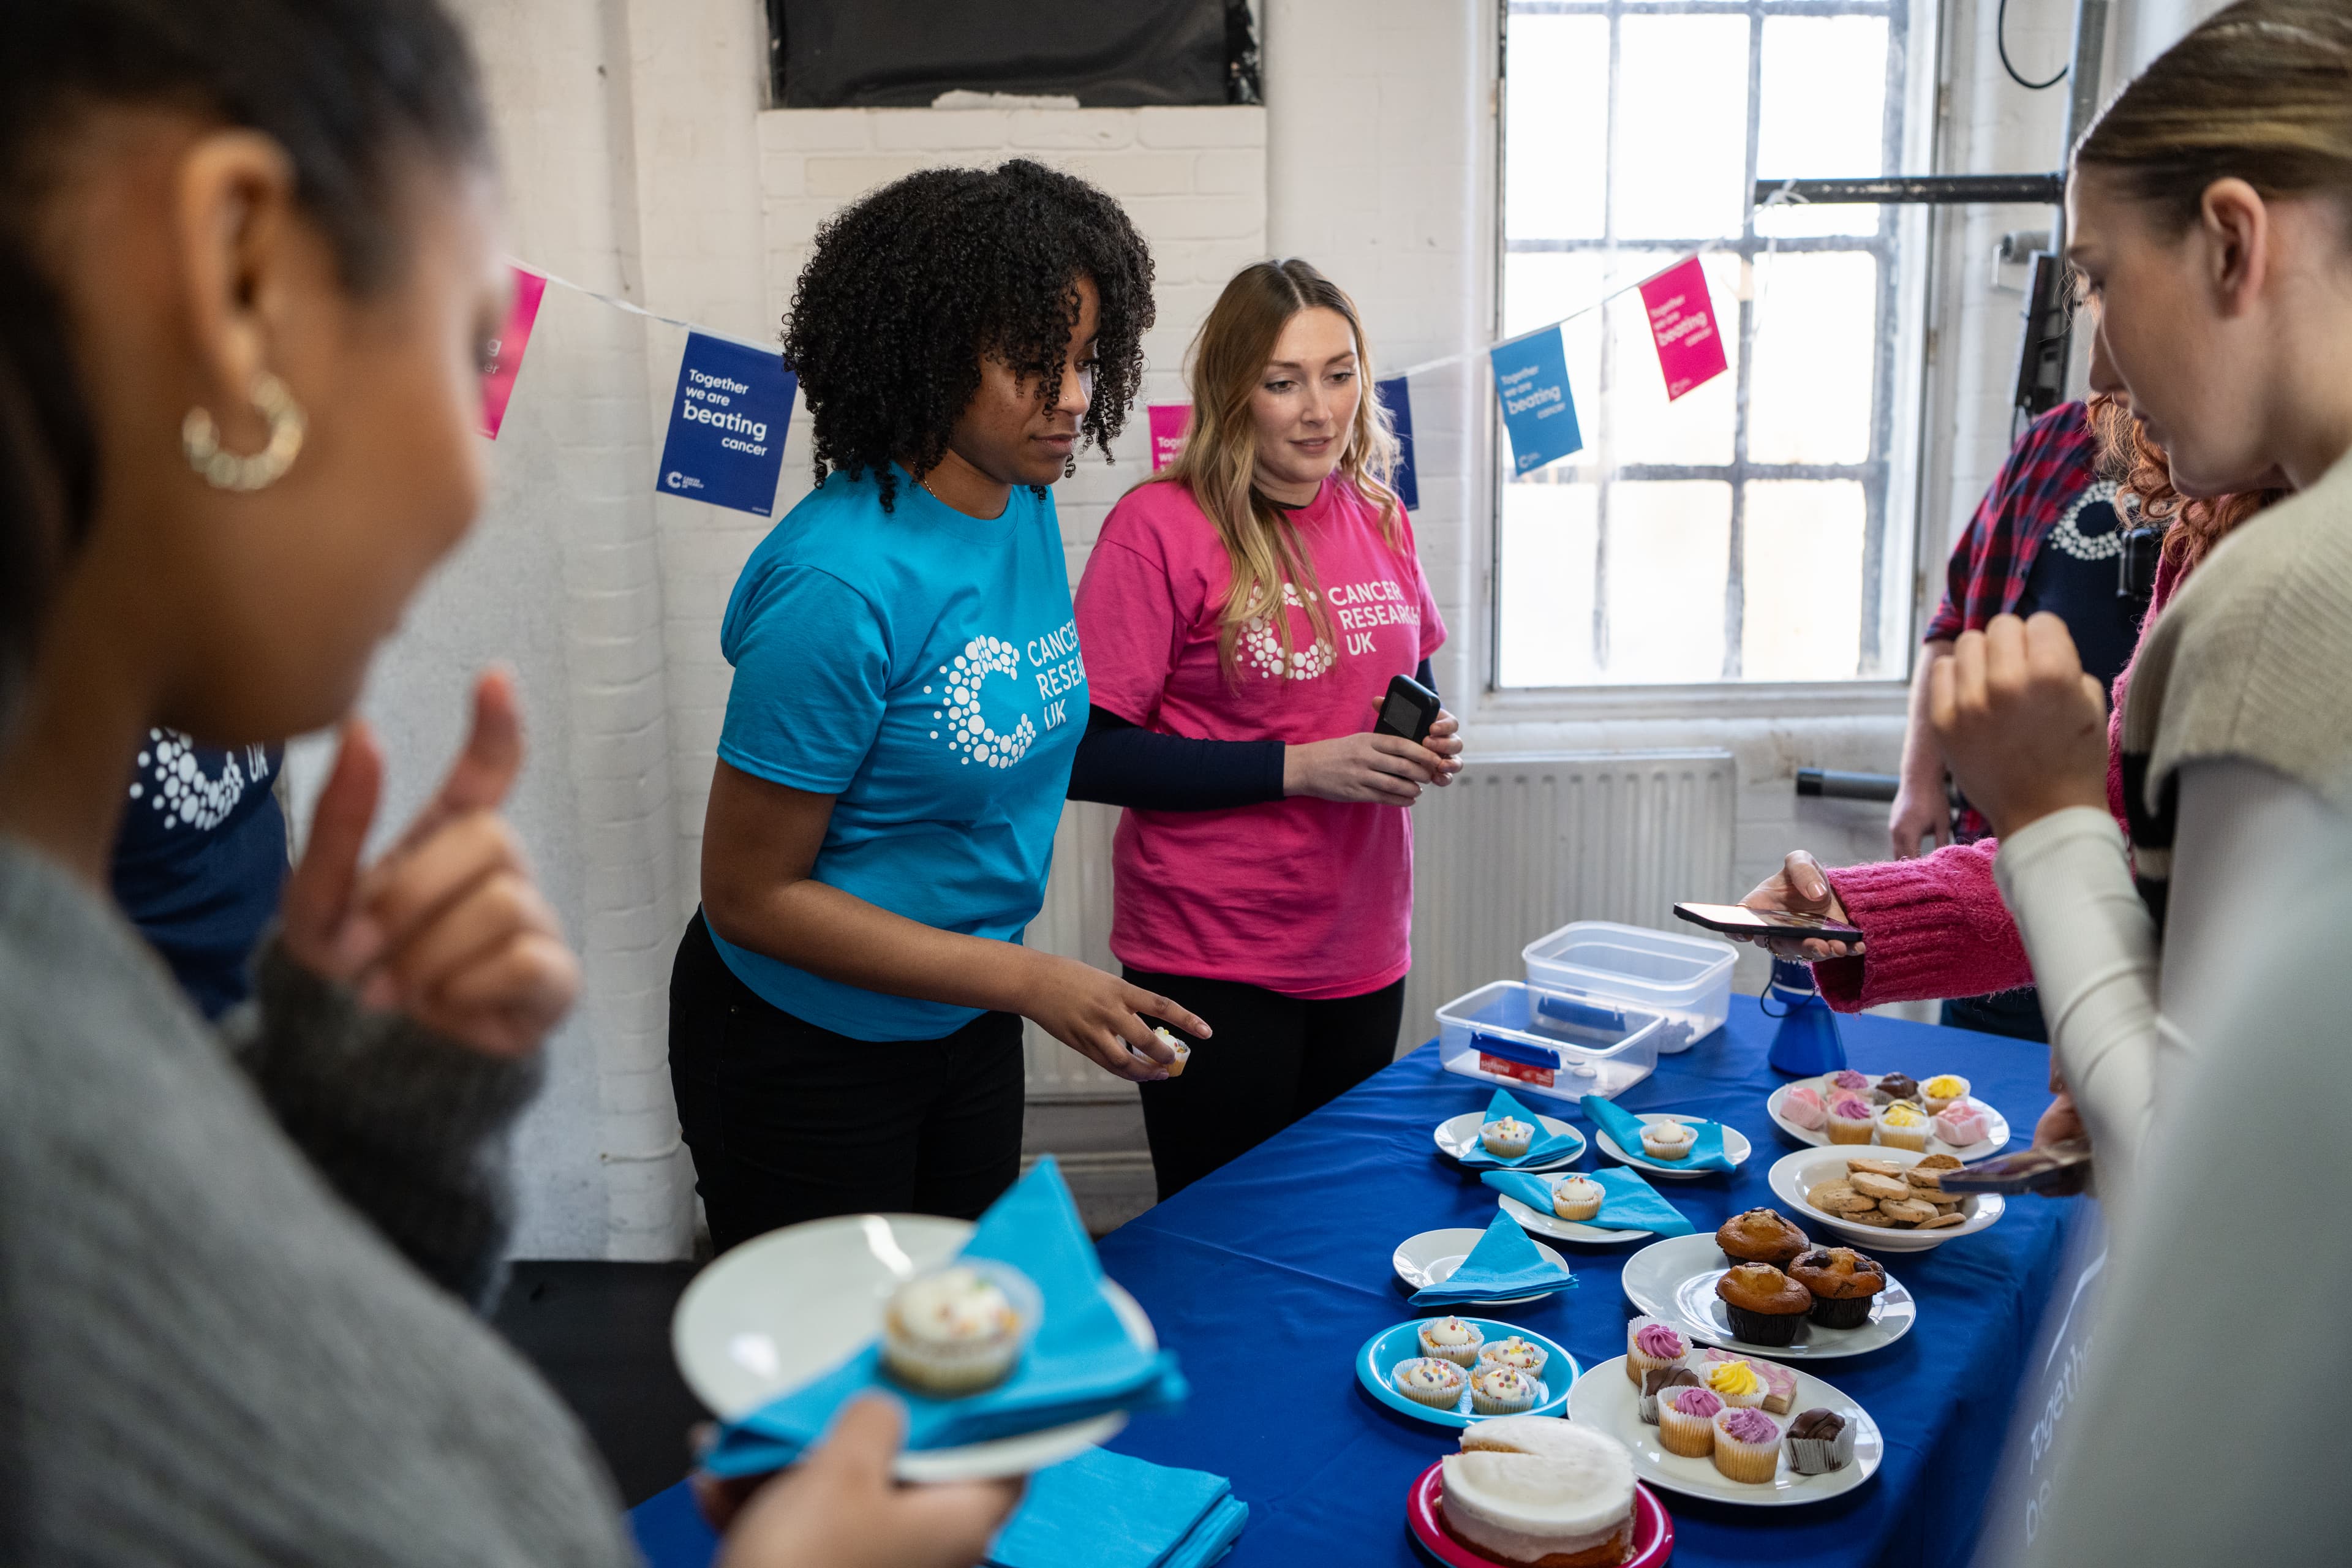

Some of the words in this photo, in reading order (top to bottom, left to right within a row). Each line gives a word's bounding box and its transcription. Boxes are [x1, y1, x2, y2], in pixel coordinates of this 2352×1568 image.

[689, 369, 749, 395] Together
[685, 386, 706, 400] we
[707, 393, 730, 406] are
[1507, 385, 1561, 415] beating
[683, 399, 767, 442] beating
[722, 437, 767, 456] cancer
[1328, 581, 1404, 606] CANCER
[1338, 604, 1420, 630] RESEARCH
[1346, 631, 1377, 656] UK
[1035, 651, 1087, 700] RESEA
[1043, 698, 1067, 731] UK
[245, 741, 269, 783] UK
